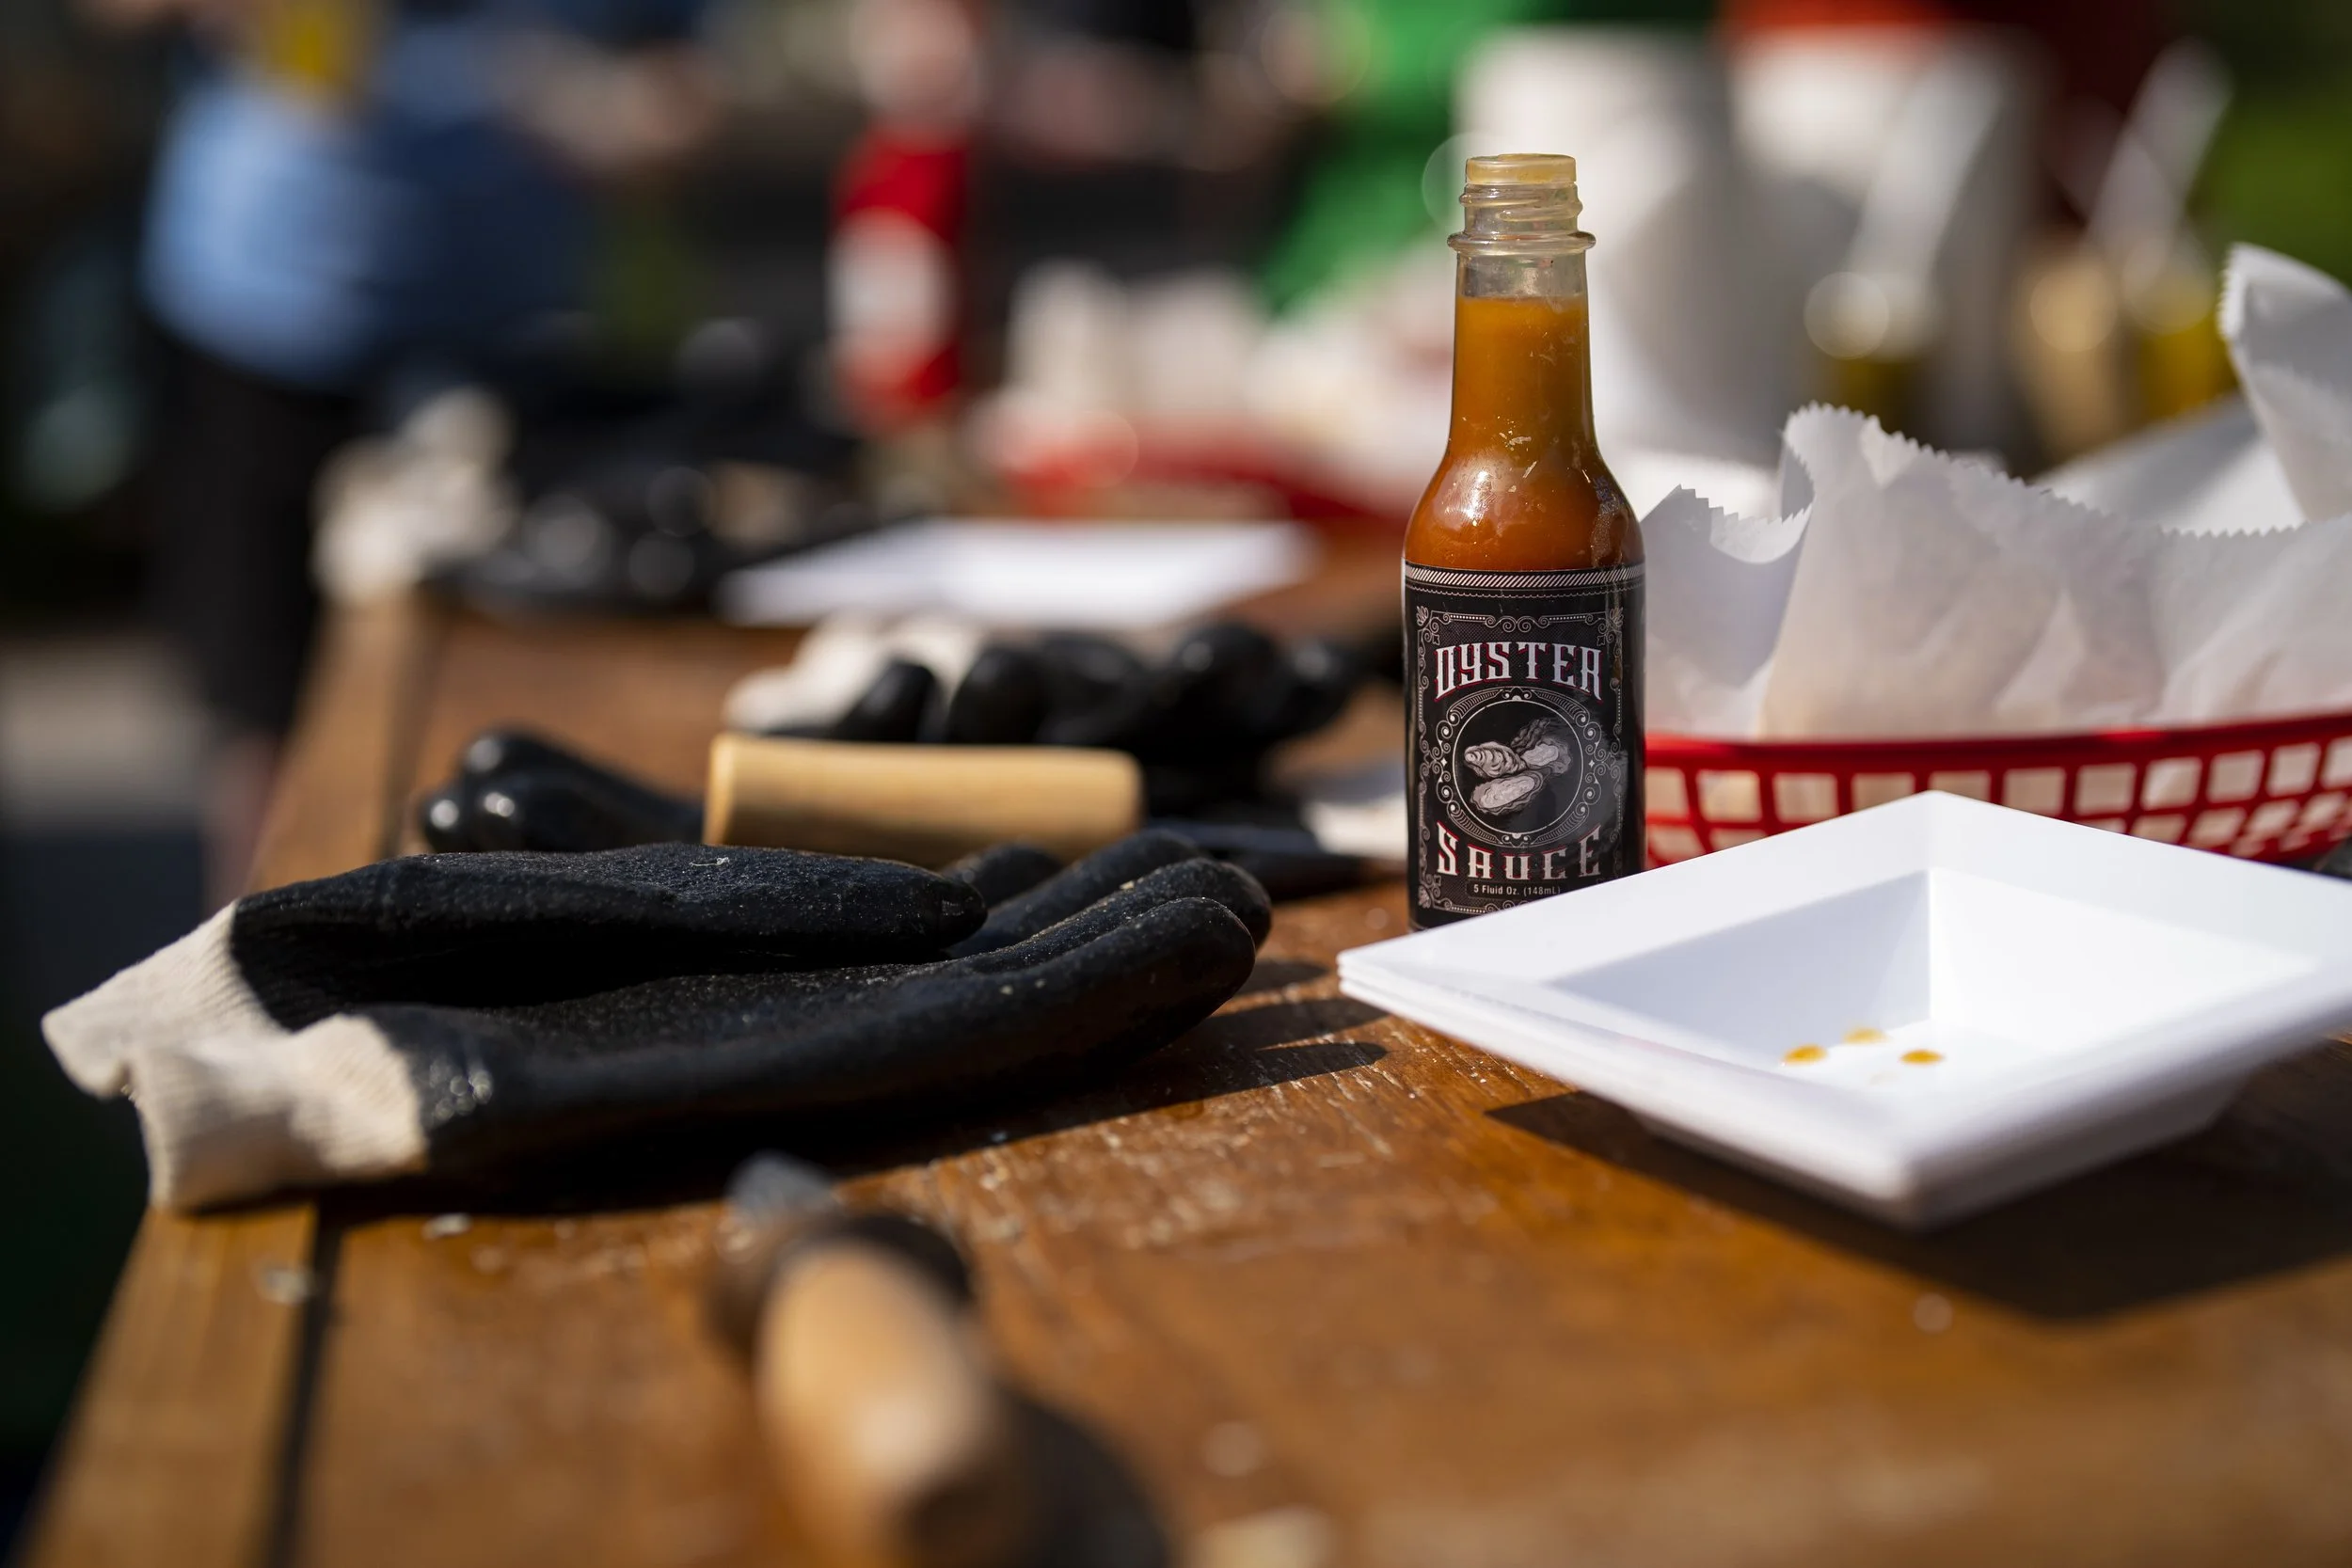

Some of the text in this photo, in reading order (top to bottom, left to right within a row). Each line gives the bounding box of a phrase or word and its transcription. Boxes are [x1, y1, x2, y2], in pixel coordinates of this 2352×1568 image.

[1434, 641, 1603, 704] OYSTER
[1437, 821, 1601, 880] SAUCE
[1472, 883, 1561, 897] 5 Fluid Oz. (148mL)
